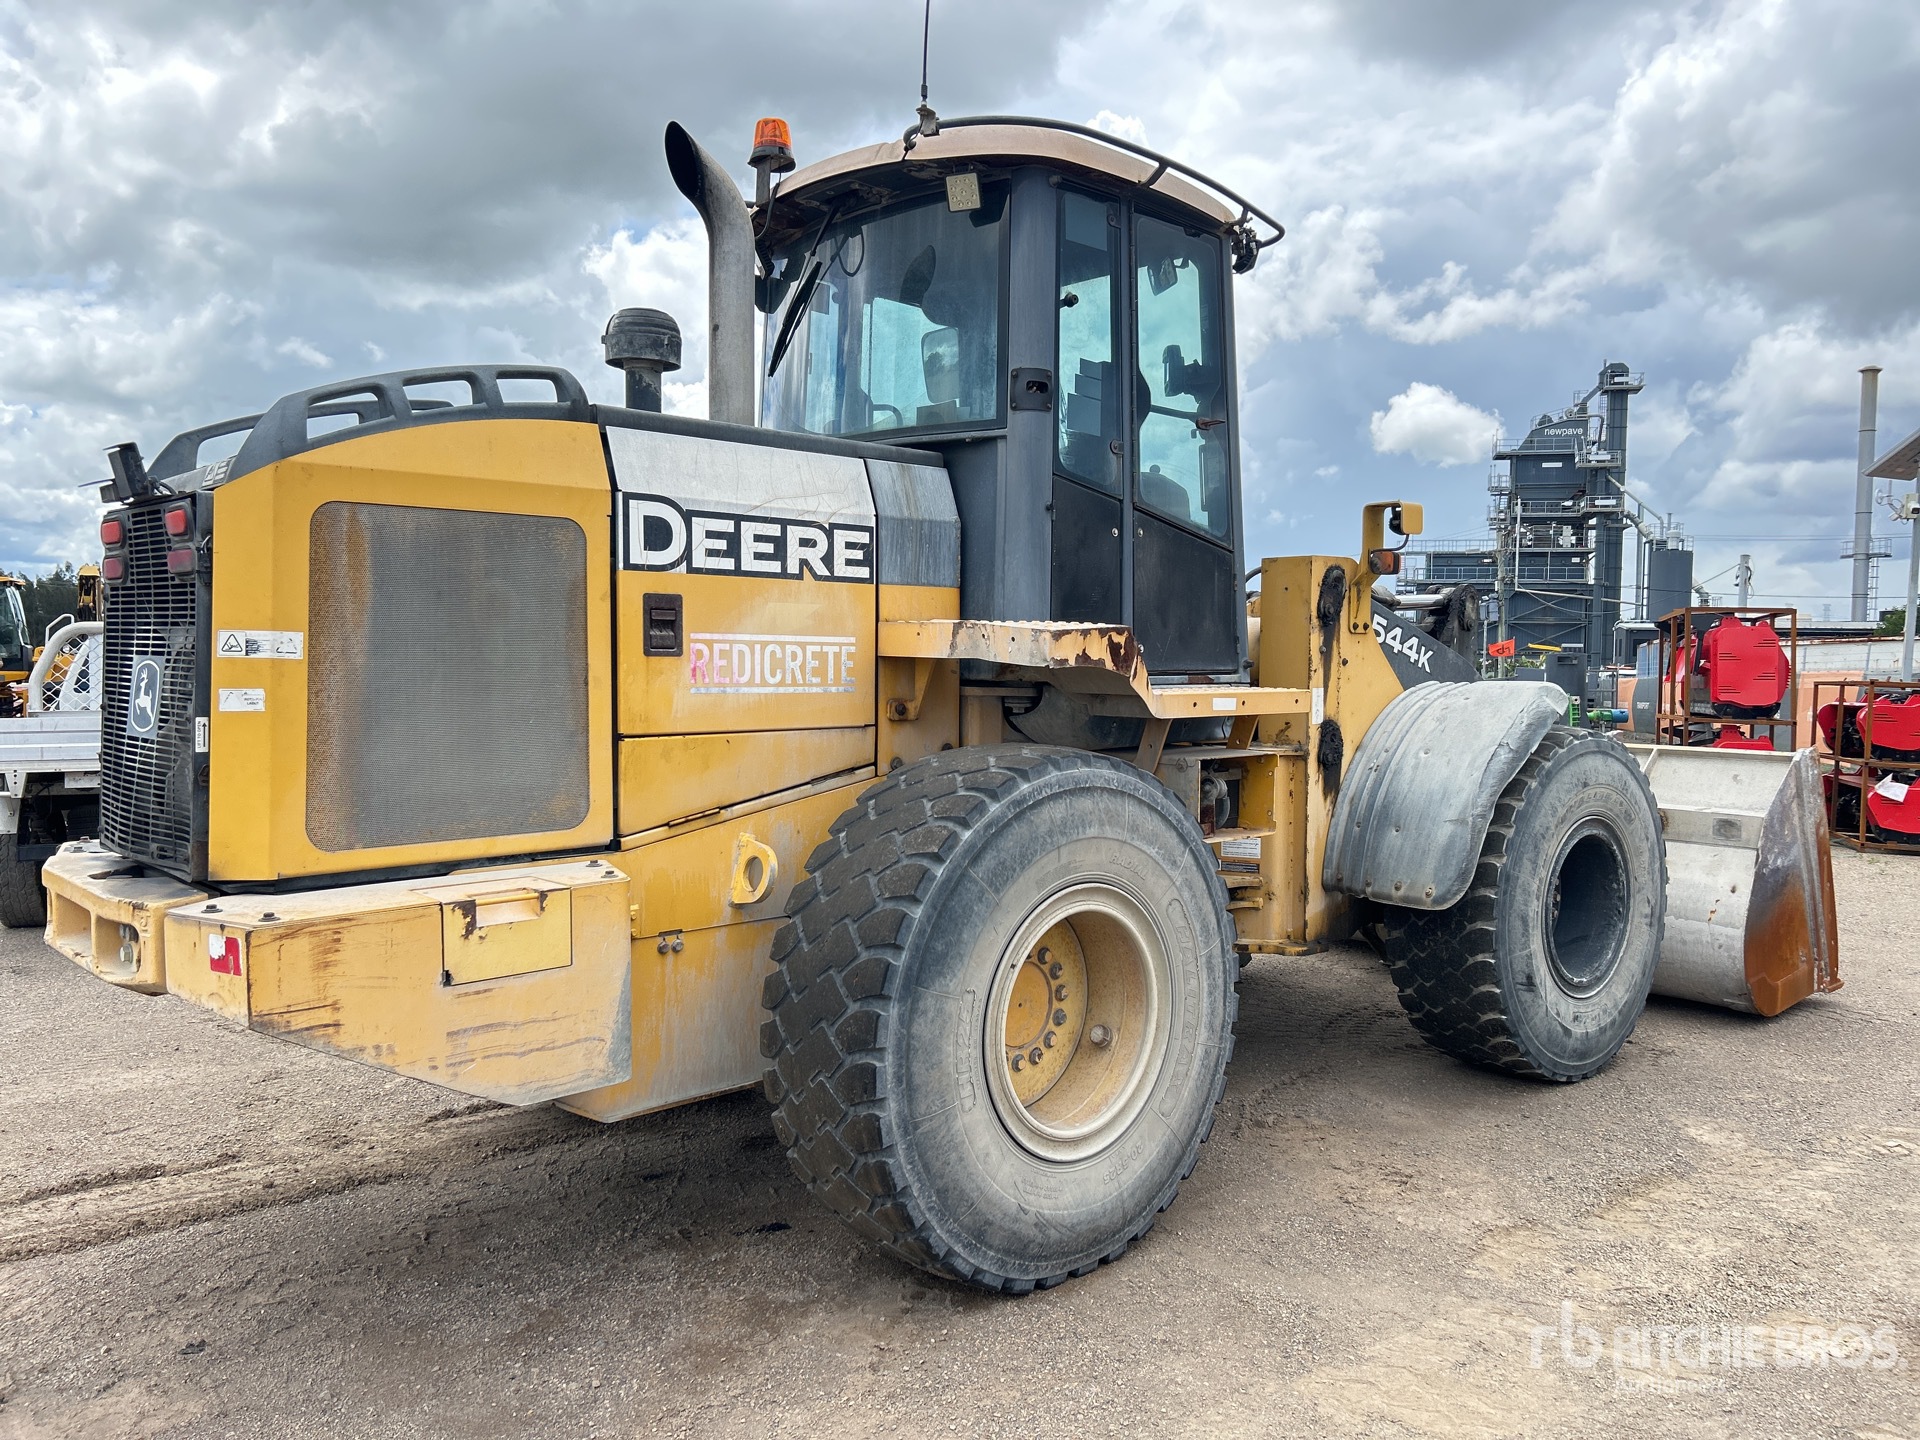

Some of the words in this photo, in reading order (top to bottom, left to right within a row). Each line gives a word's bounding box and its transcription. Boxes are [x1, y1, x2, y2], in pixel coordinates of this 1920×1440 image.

[1544, 427, 1583, 437] newpave
[626, 497, 871, 580] DEERE
[690, 642, 856, 684] REDICRETE
[1372, 613, 1434, 674] 544K
[1109, 852, 1148, 880] RADIAL
[1174, 926, 1198, 1095] HALITRAX
